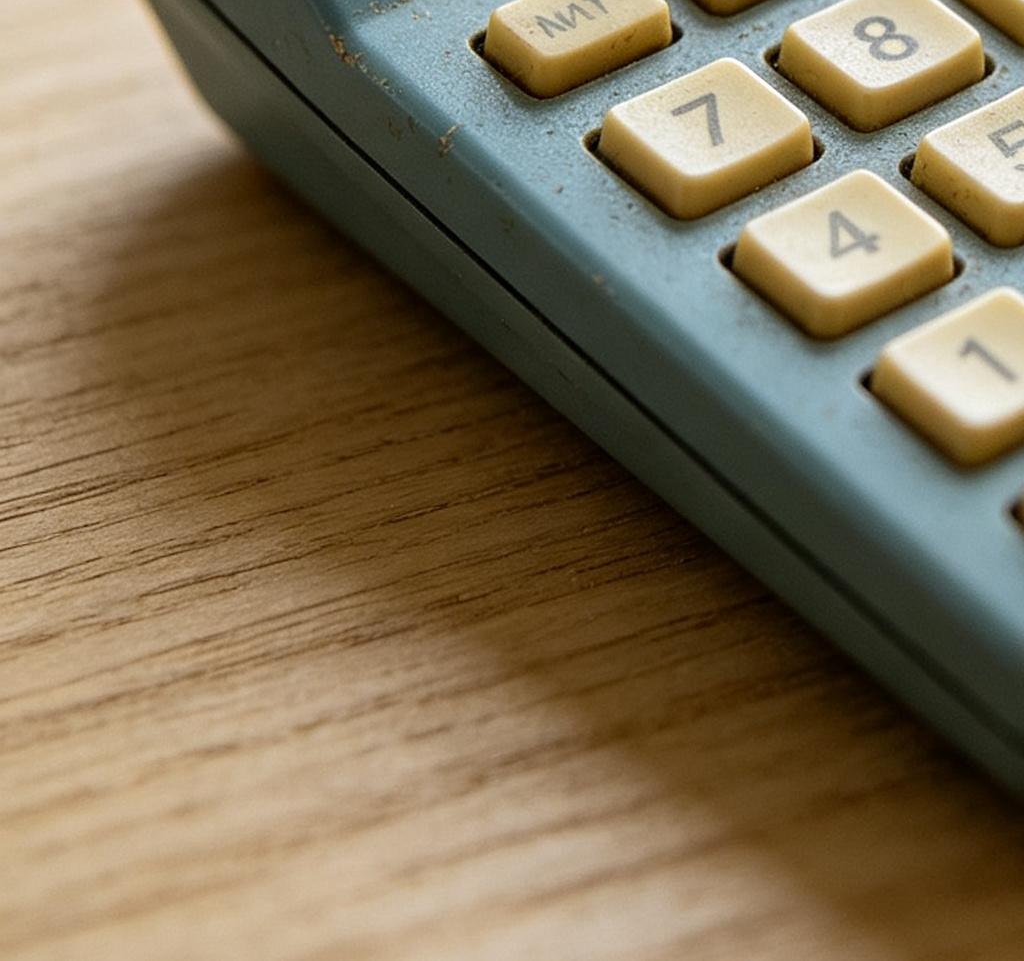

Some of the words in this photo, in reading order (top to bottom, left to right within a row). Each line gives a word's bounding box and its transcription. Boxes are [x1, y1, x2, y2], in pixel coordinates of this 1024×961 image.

[853, 15, 919, 62] 8
[671, 91, 728, 147] 7
[826, 209, 881, 260] 4
[957, 337, 1019, 384] 1
